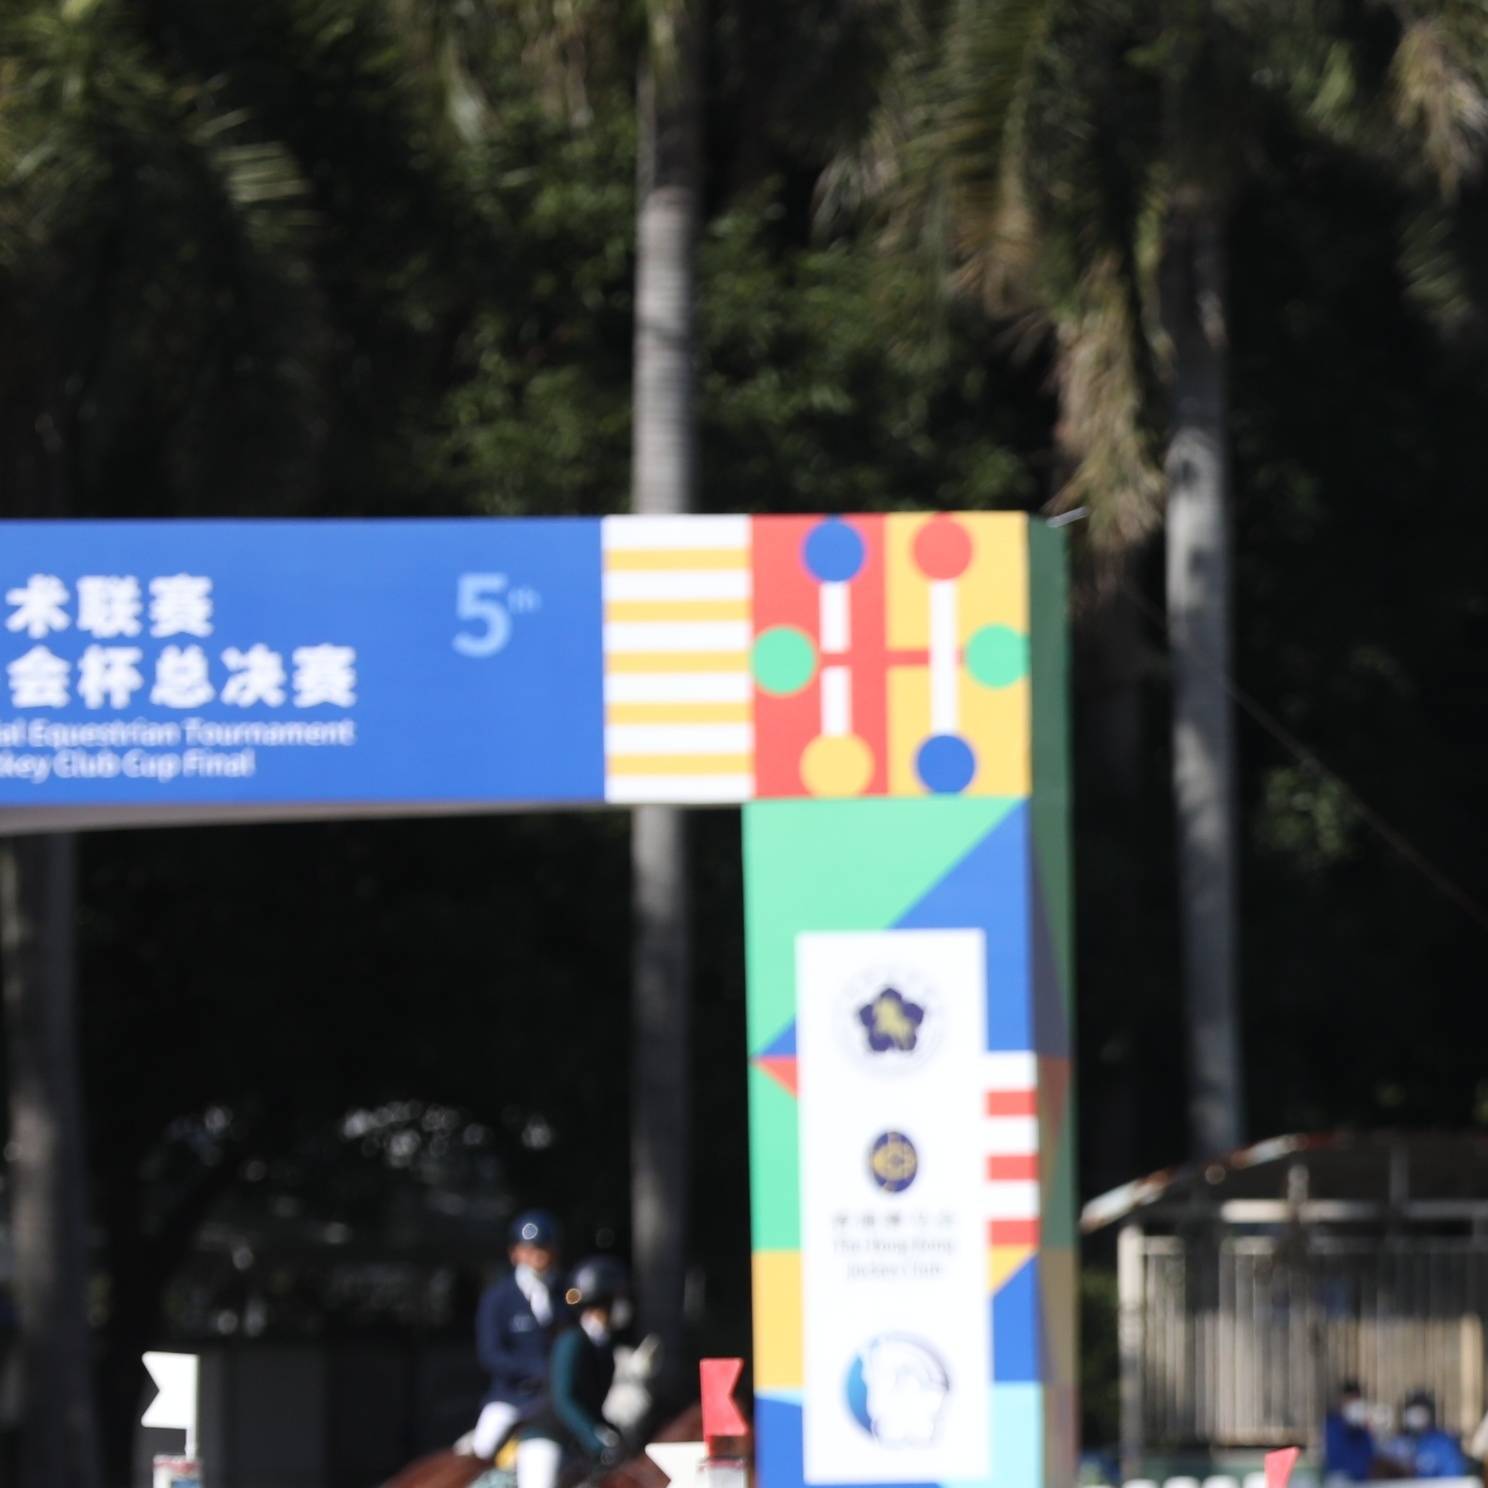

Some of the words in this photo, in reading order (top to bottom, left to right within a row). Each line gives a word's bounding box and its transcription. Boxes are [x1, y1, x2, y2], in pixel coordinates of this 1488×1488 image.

[5, 573, 212, 638] 术联赛
[6, 643, 357, 708] 会杯总决赛
[28, 717, 182, 748] Equestrian
[184, 717, 356, 747] Tournament
[53, 749, 120, 778] Club
[122, 749, 182, 784] Cup
[183, 747, 257, 778] Final
